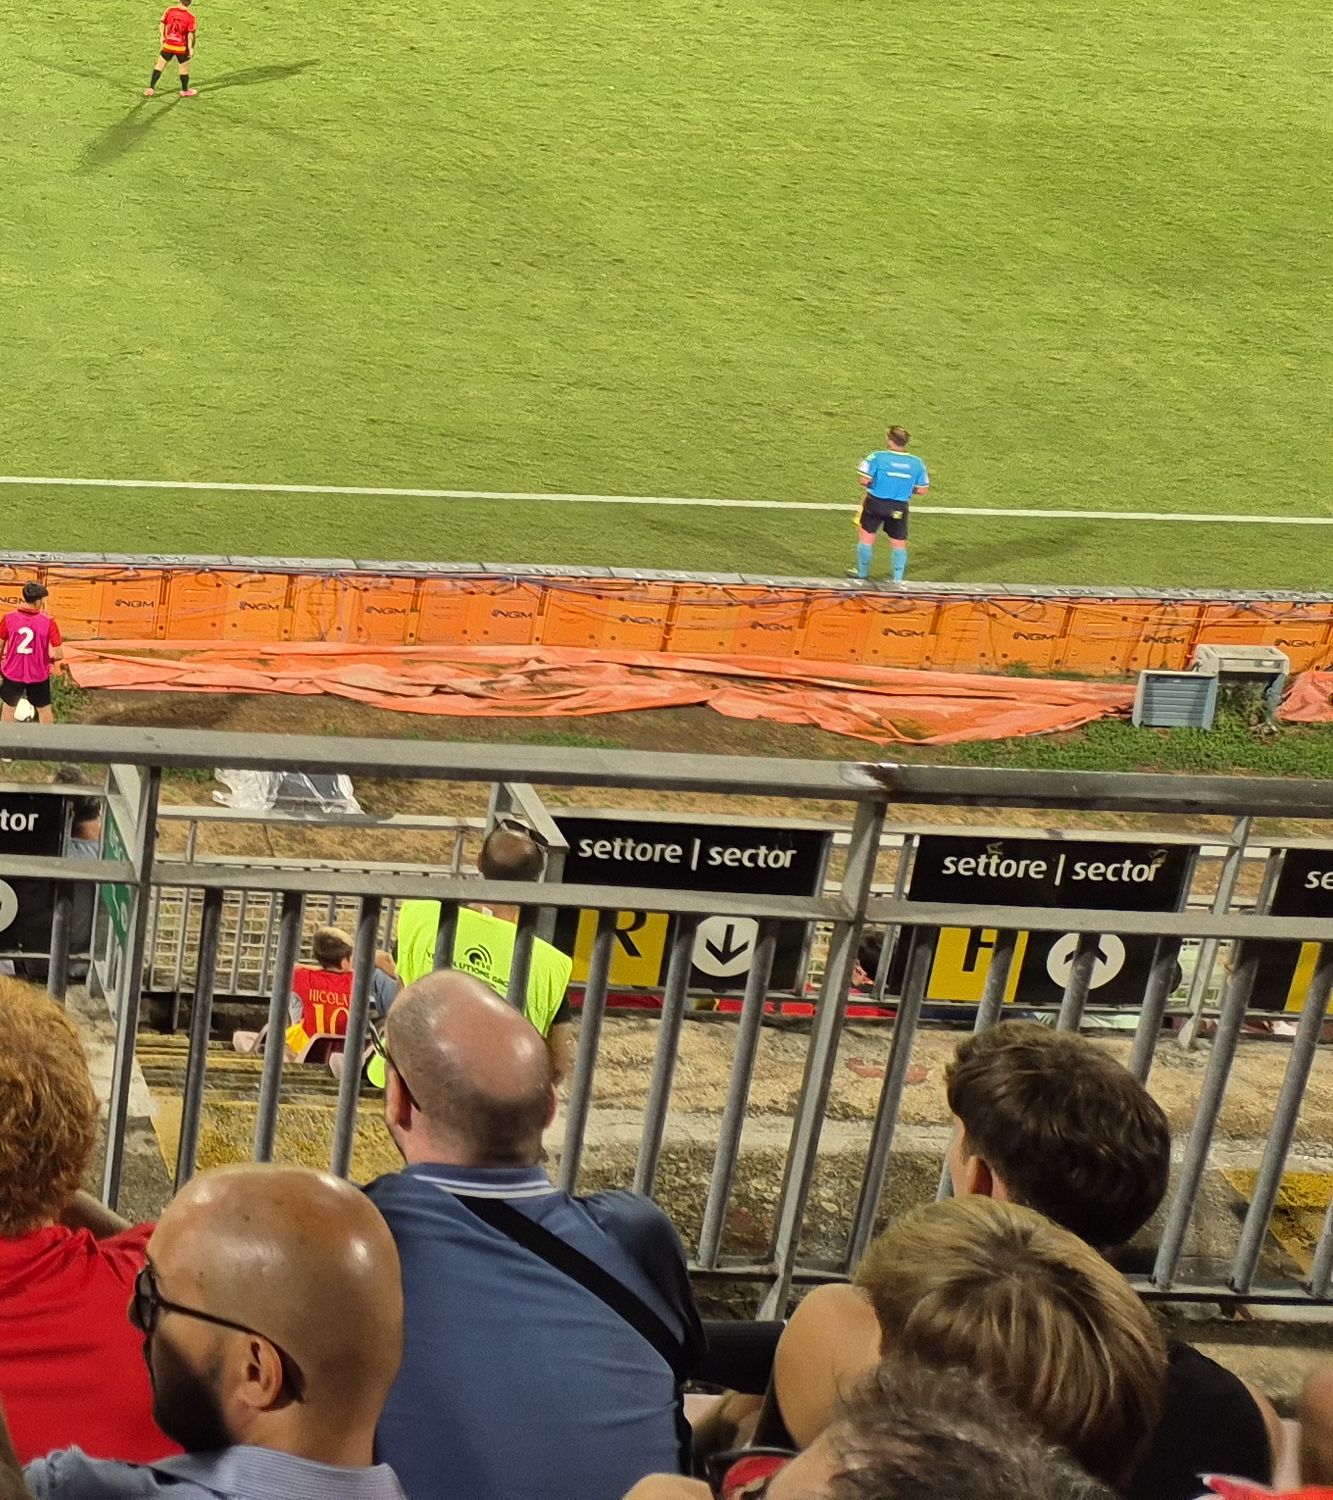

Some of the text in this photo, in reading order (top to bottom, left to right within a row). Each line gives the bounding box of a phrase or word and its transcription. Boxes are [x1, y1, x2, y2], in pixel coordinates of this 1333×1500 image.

[16, 626, 35, 655] 2
[577, 835, 797, 869] settore sector
[941, 852, 1162, 883] settore sector
